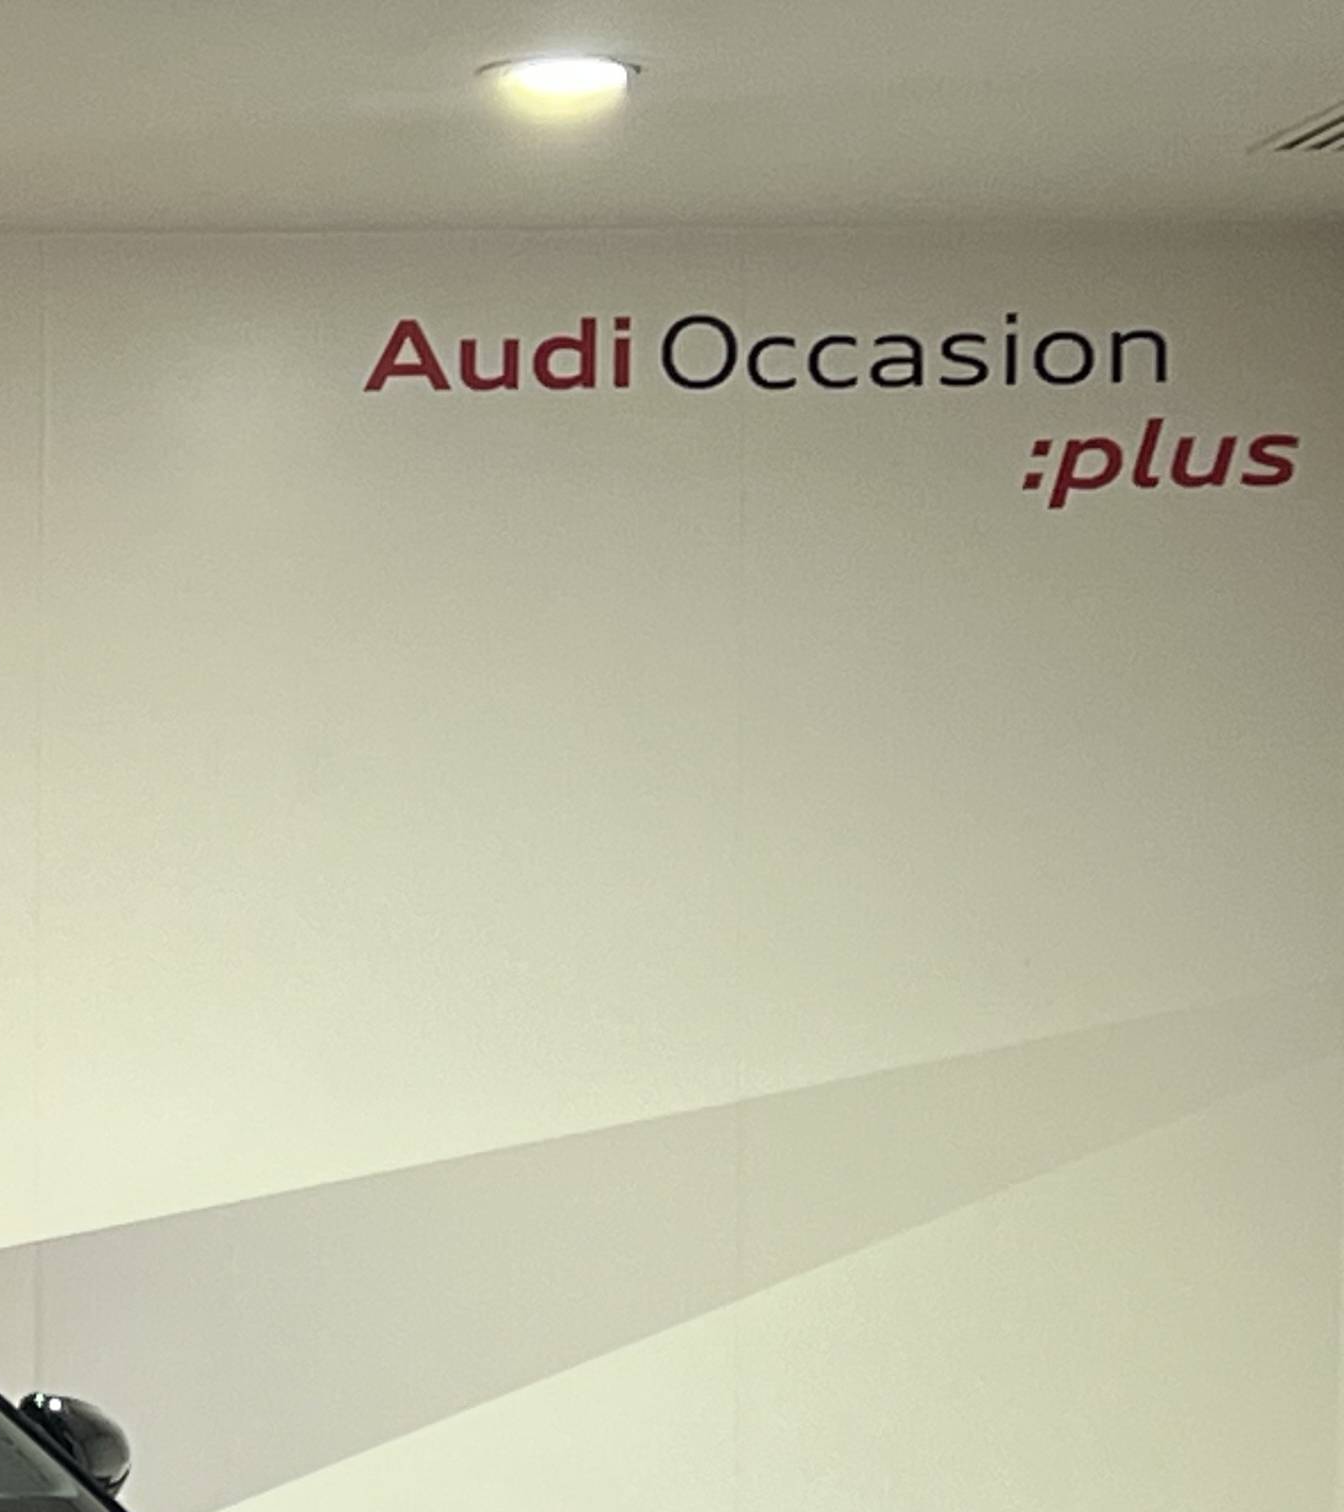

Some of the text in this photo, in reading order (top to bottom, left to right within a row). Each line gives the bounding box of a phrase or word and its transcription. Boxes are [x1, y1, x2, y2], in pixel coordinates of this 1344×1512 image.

[363, 312, 1168, 393] Audi Occasion
[1021, 417, 1301, 510] :plus
